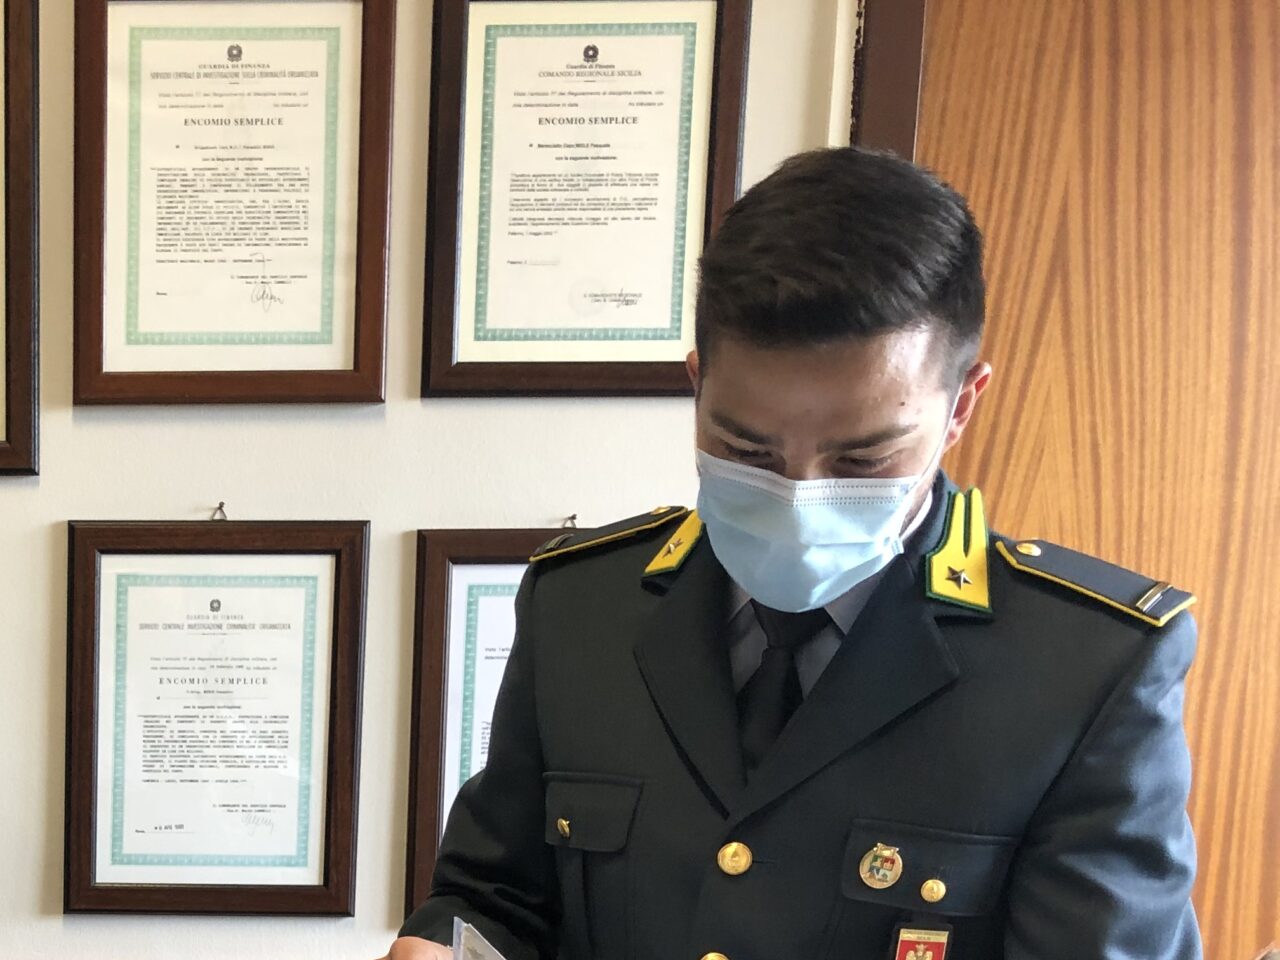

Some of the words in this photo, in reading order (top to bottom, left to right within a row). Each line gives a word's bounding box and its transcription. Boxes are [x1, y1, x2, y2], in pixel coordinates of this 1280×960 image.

[183, 117, 232, 126] ENCOMIO
[234, 117, 284, 126] SEMPLICE
[538, 117, 586, 125] ENCOMIO
[587, 116, 639, 125] SEMPLICE
[159, 677, 209, 685] ENCOMIO
[214, 677, 269, 685] SEMPLICE
